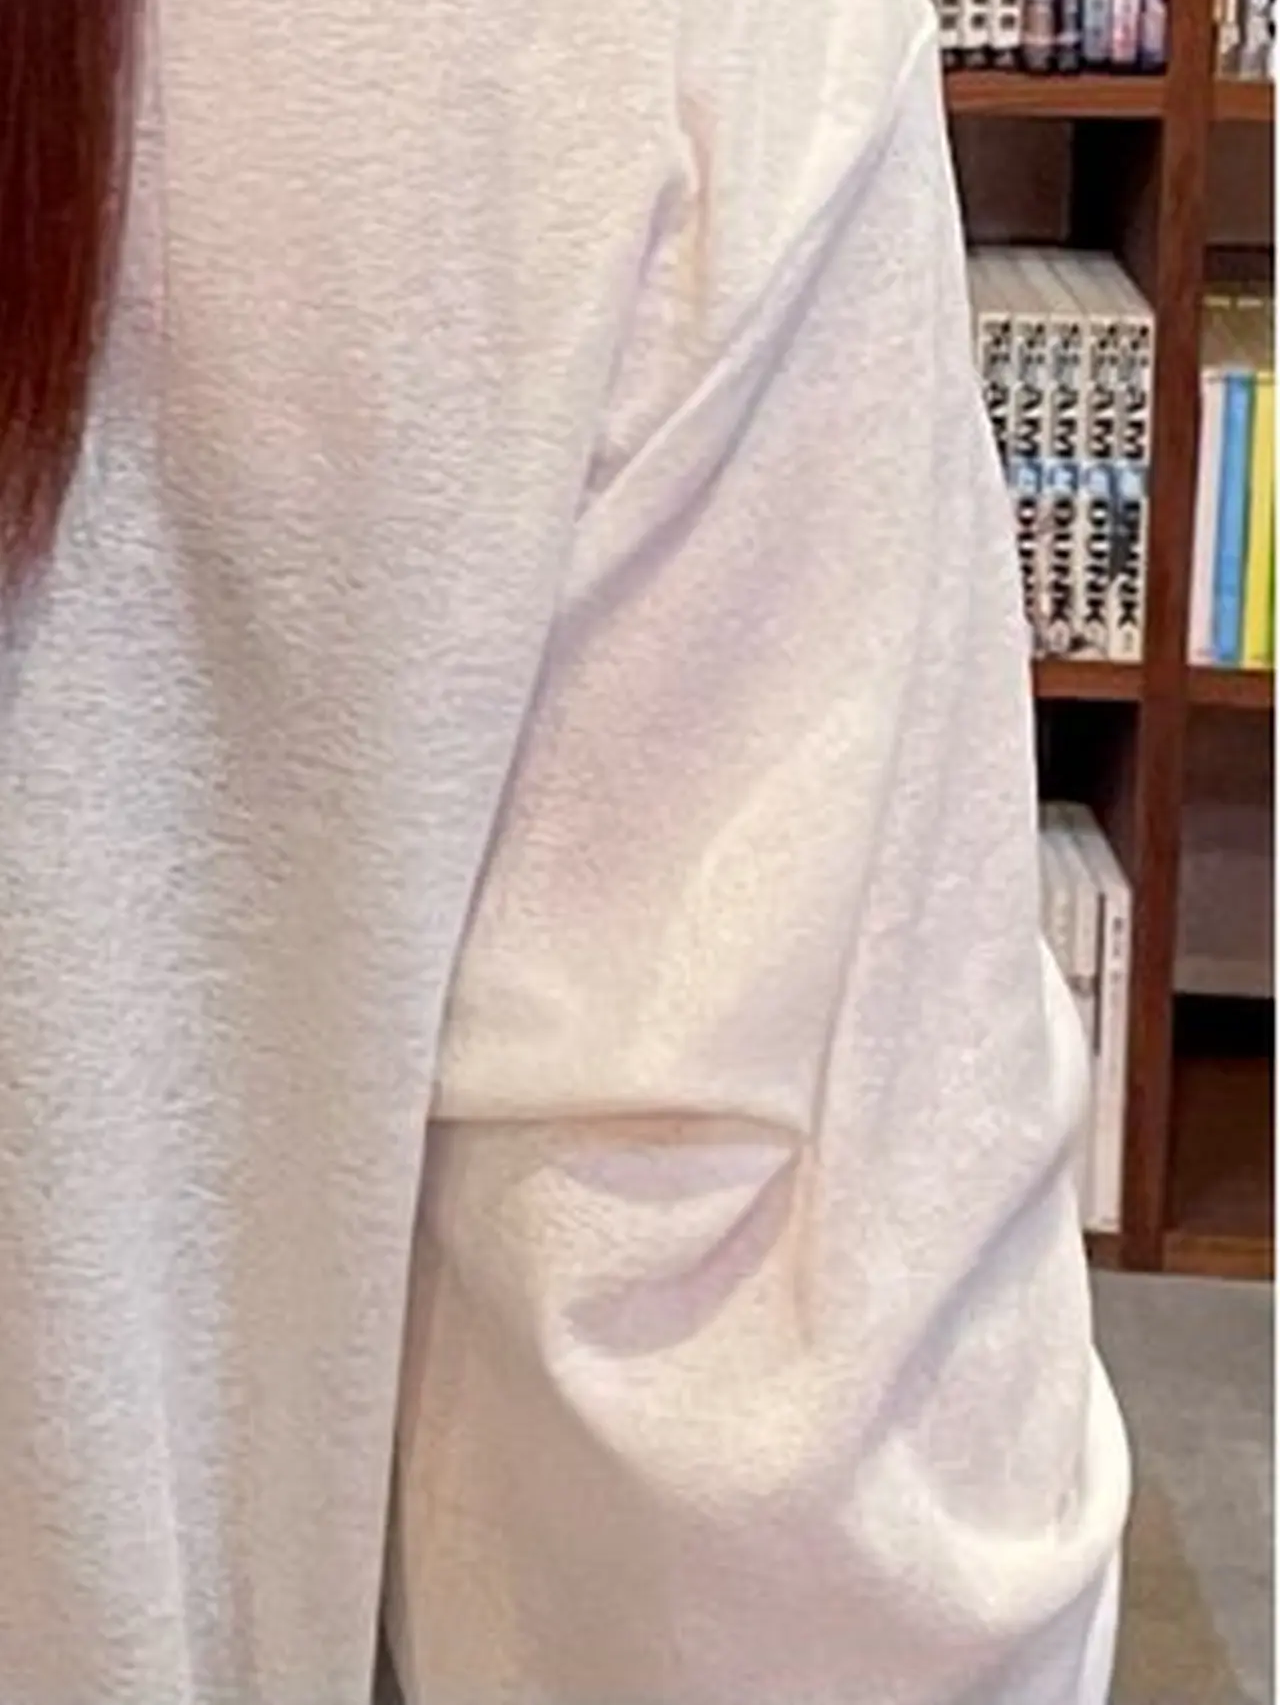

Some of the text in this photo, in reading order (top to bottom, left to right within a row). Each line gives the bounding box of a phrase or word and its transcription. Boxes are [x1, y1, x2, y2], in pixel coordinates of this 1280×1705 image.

[1015, 318, 1047, 459] SLAM
[1050, 318, 1080, 625] SLAM DUNK
[1085, 318, 1117, 625] SLAM DUNK
[1118, 319, 1149, 459] SLAM
